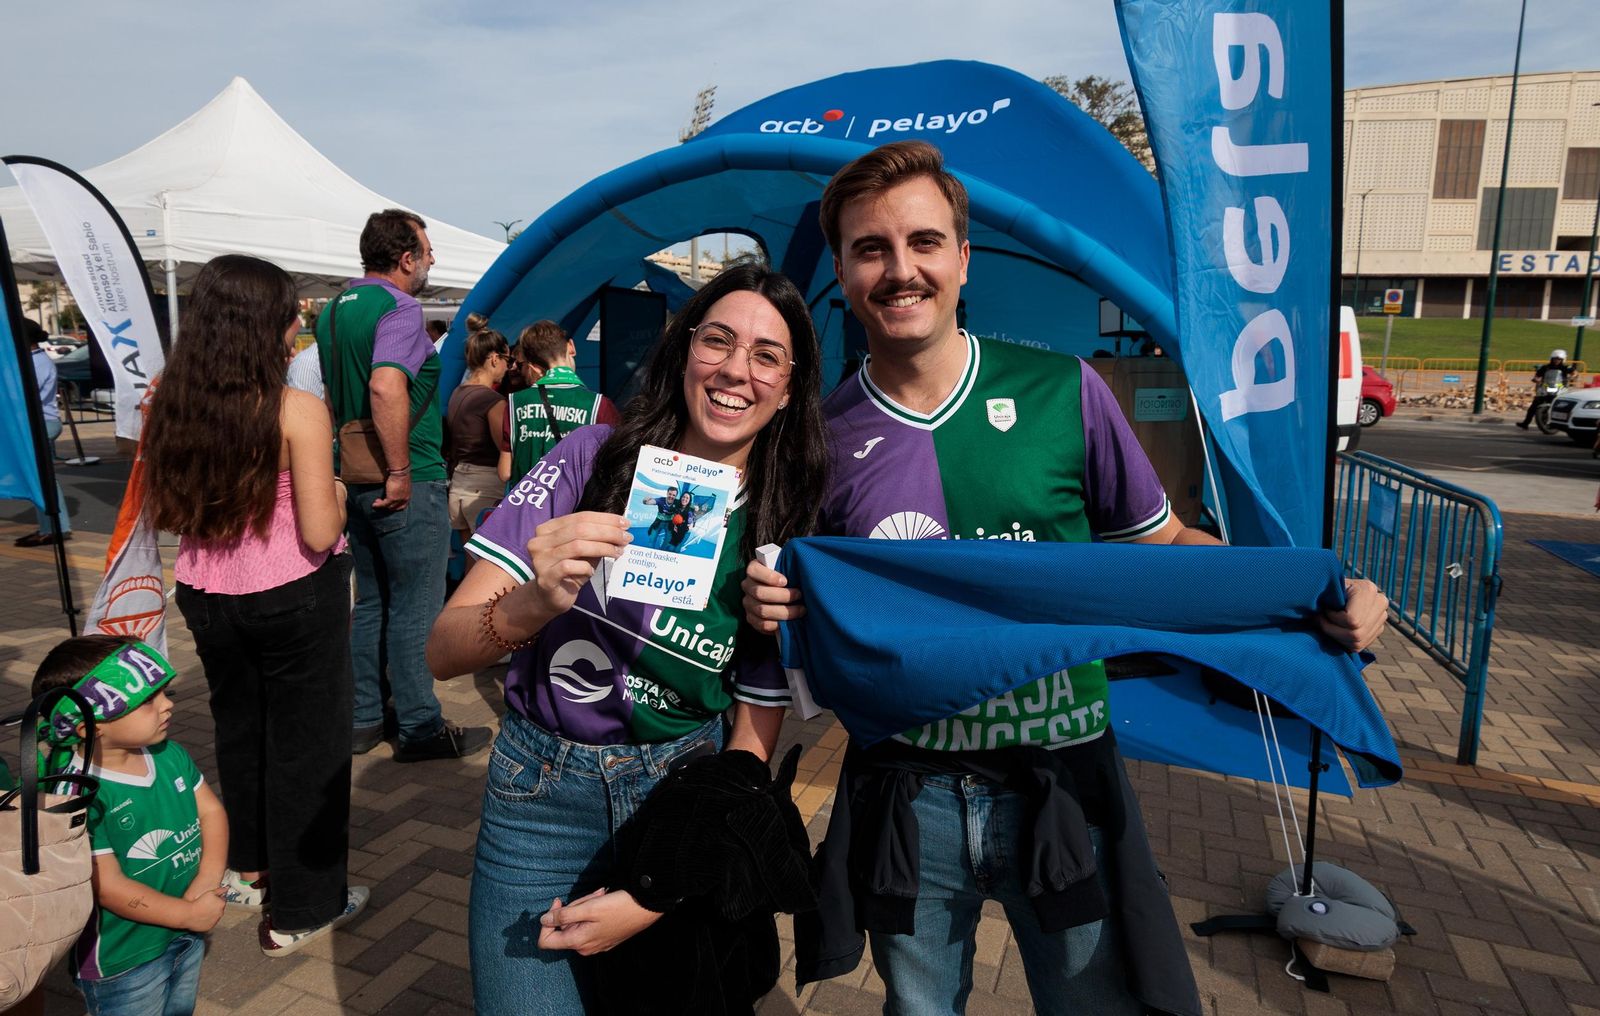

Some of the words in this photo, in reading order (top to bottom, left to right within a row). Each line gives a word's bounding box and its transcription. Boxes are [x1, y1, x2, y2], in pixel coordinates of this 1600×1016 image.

[760, 118, 824, 134] acb
[868, 108, 988, 138] pelayo
[82, 221, 99, 252] Sabio
[103, 242, 122, 286] Nostrum
[100, 273, 118, 312] Alfonso
[114, 286, 128, 312] Mare
[653, 455, 674, 467] acb
[686, 463, 718, 478] pelayo
[628, 557, 657, 569] contigo,
[630, 549, 644, 557] con
[653, 553, 679, 565] basket,
[622, 571, 685, 595] pelayo
[671, 594, 694, 606] está.
[649, 608, 735, 668] Unicaja
